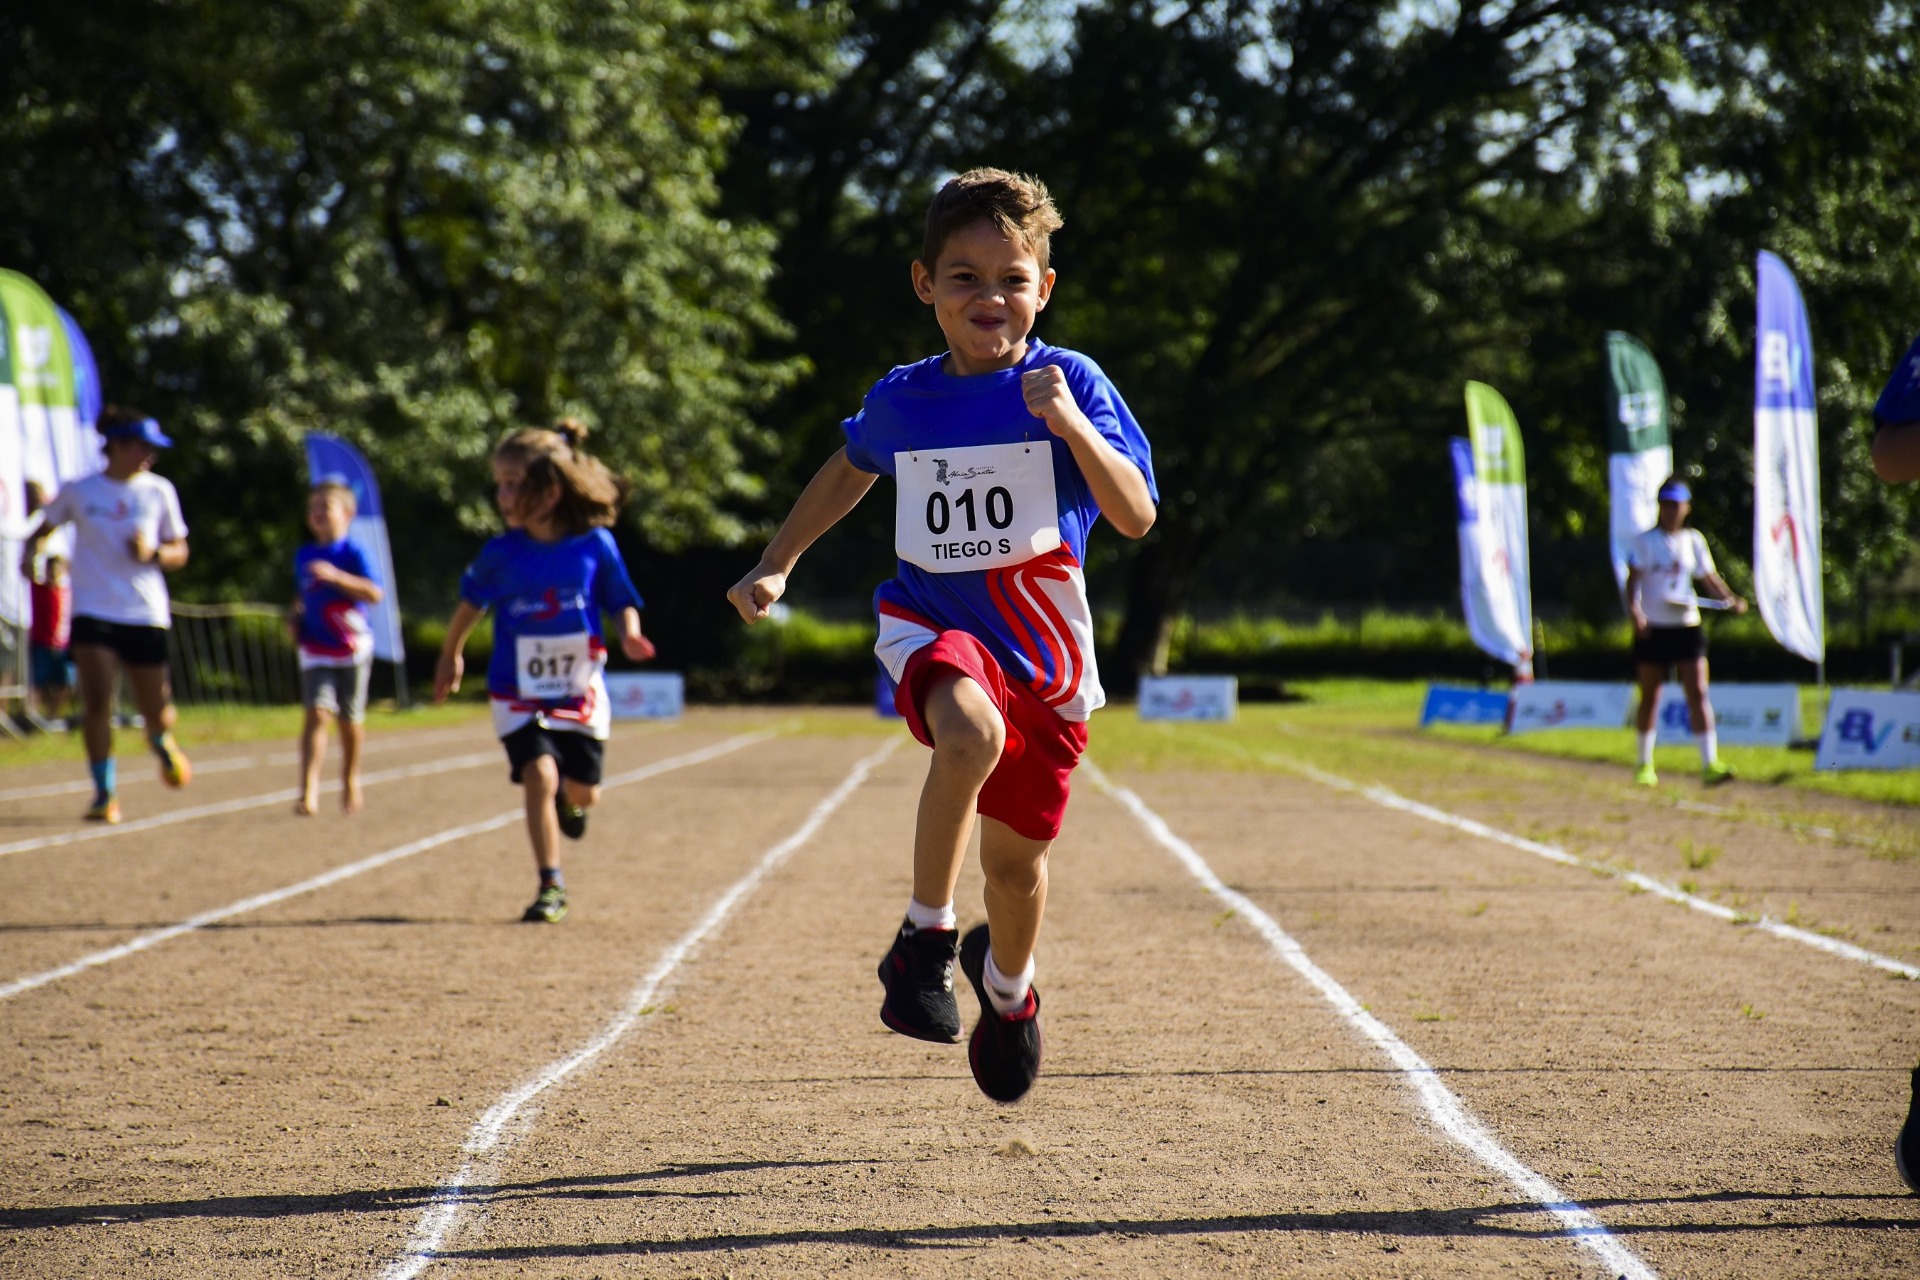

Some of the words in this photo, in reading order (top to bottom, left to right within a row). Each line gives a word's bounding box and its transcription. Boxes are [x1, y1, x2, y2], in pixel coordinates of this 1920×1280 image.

[926, 486, 1014, 535] 010
[931, 539, 992, 559] TIEGO
[998, 538, 1011, 554] S
[527, 654, 576, 679] 017
